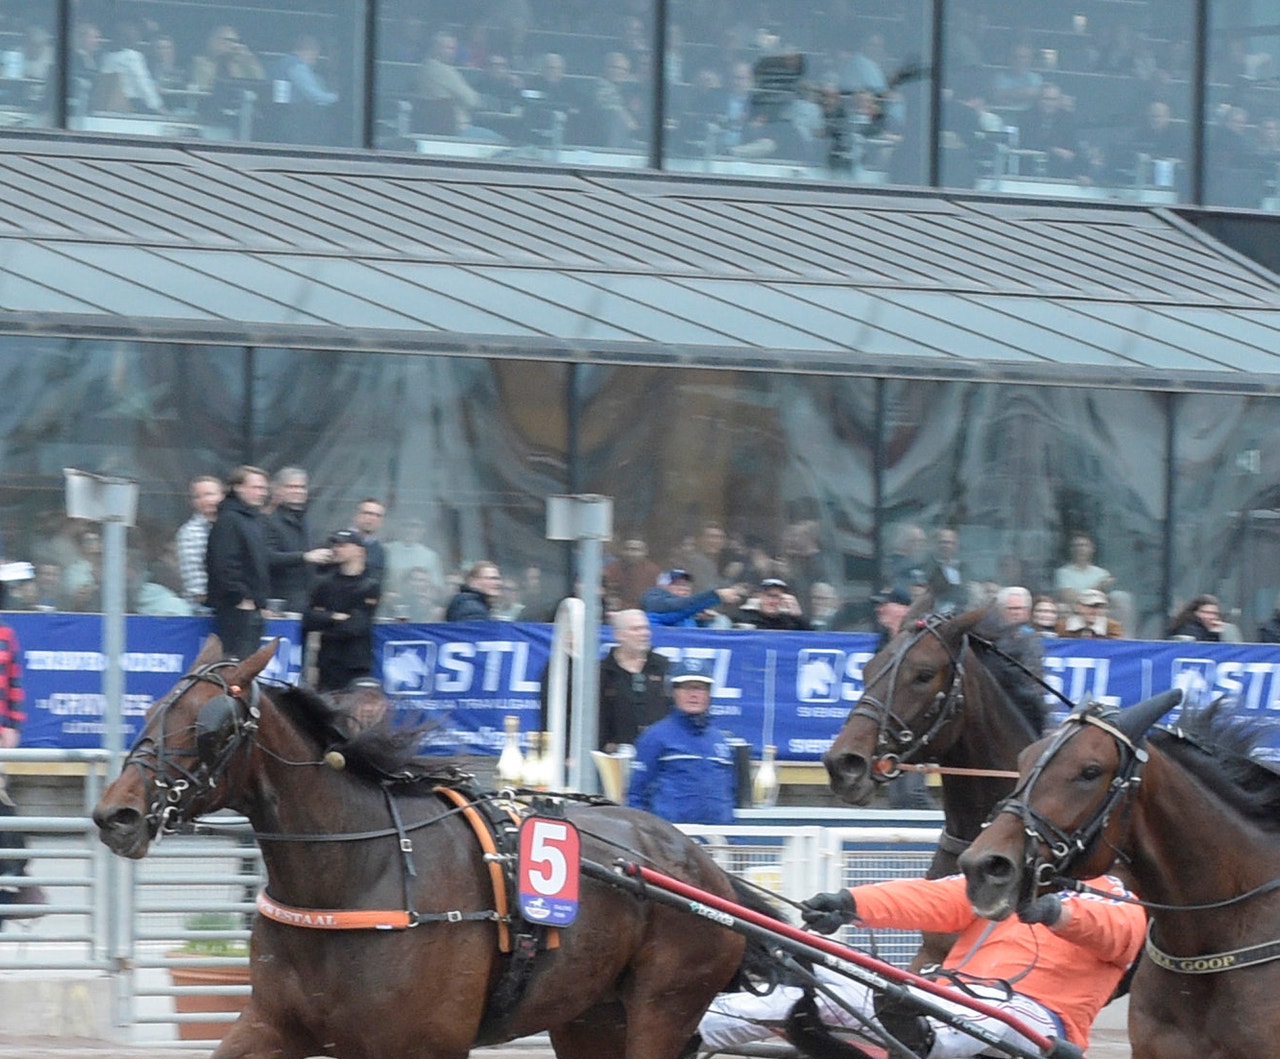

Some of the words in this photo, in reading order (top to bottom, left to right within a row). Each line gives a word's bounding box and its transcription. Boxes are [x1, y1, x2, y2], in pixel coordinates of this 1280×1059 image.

[435, 641, 541, 692] STL
[529, 822, 567, 895] 5
[1180, 956, 1235, 971] GOOP
